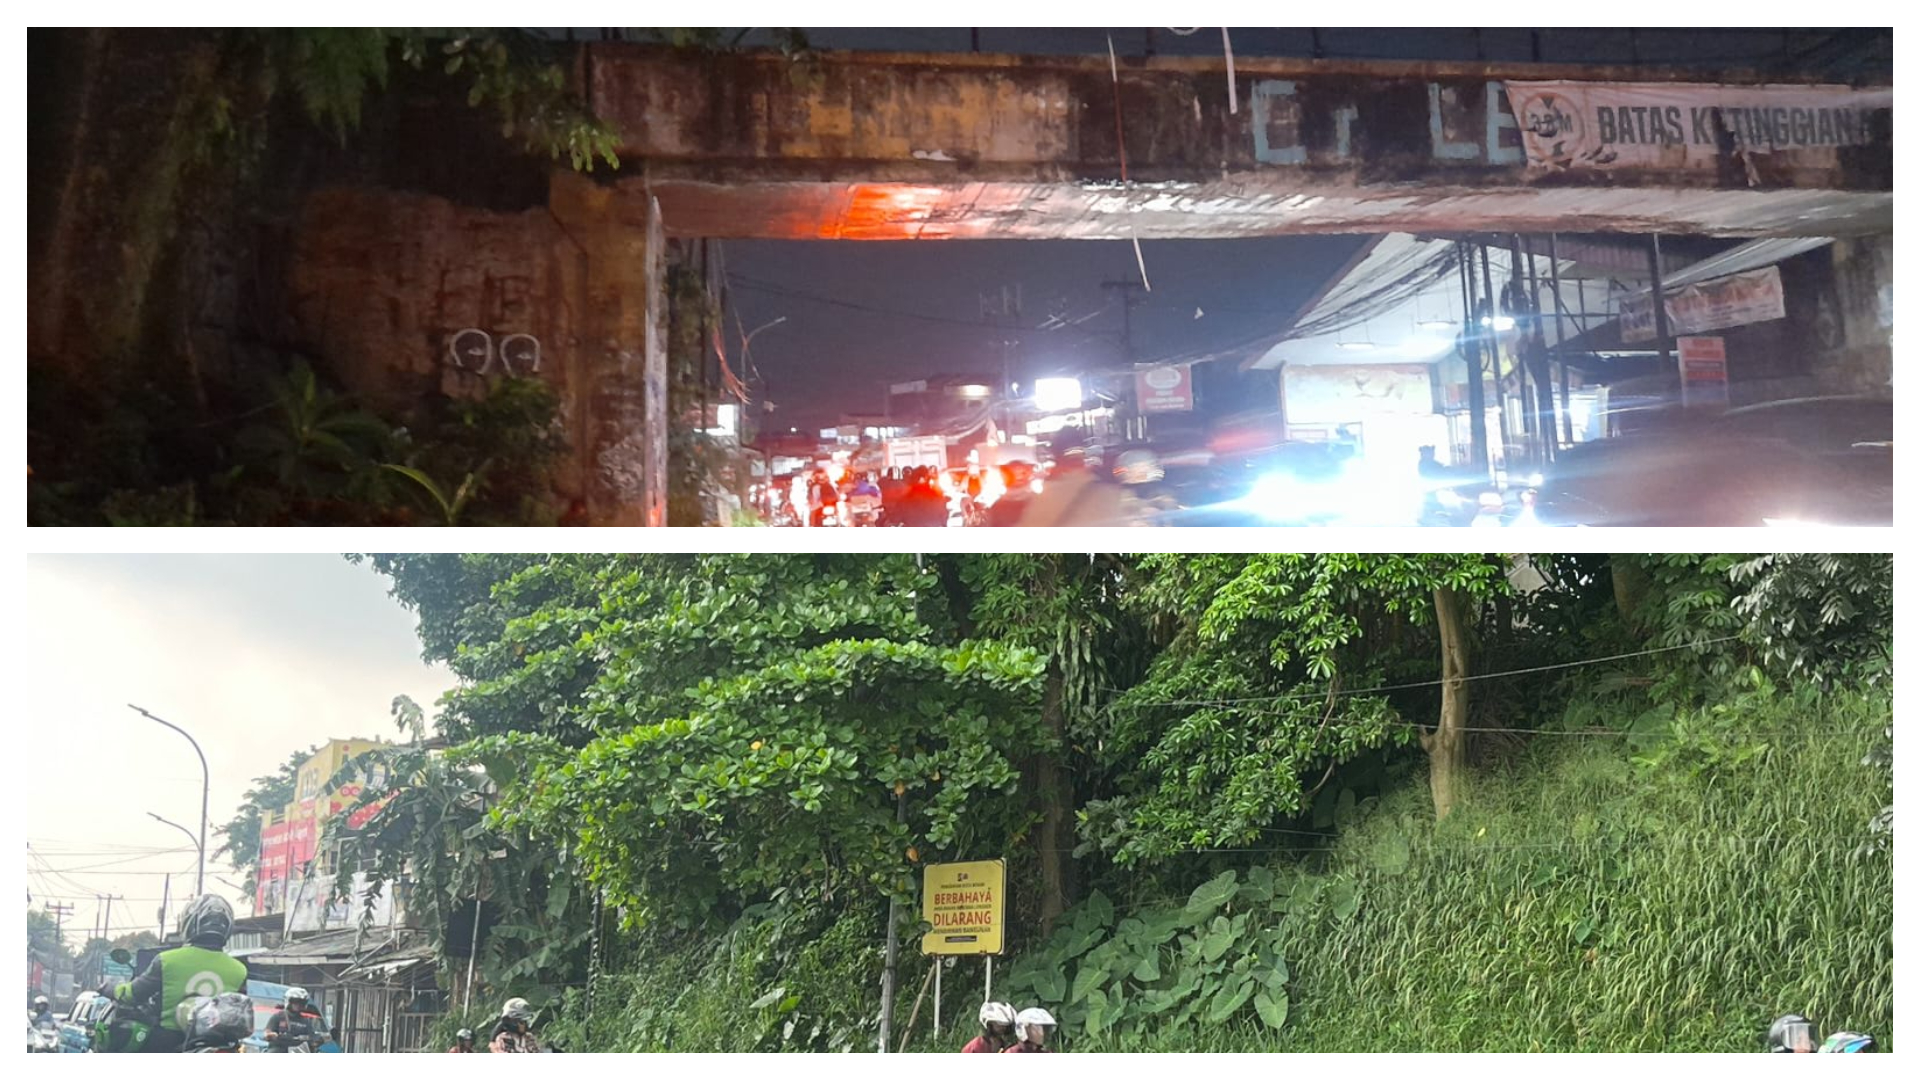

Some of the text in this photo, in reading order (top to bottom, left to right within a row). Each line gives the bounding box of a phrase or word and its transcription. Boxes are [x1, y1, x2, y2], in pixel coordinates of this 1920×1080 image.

[1597, 105, 1685, 144] BATAS
[934, 890, 992, 905] BERBAHAYA
[933, 911, 991, 926] DILARANG
